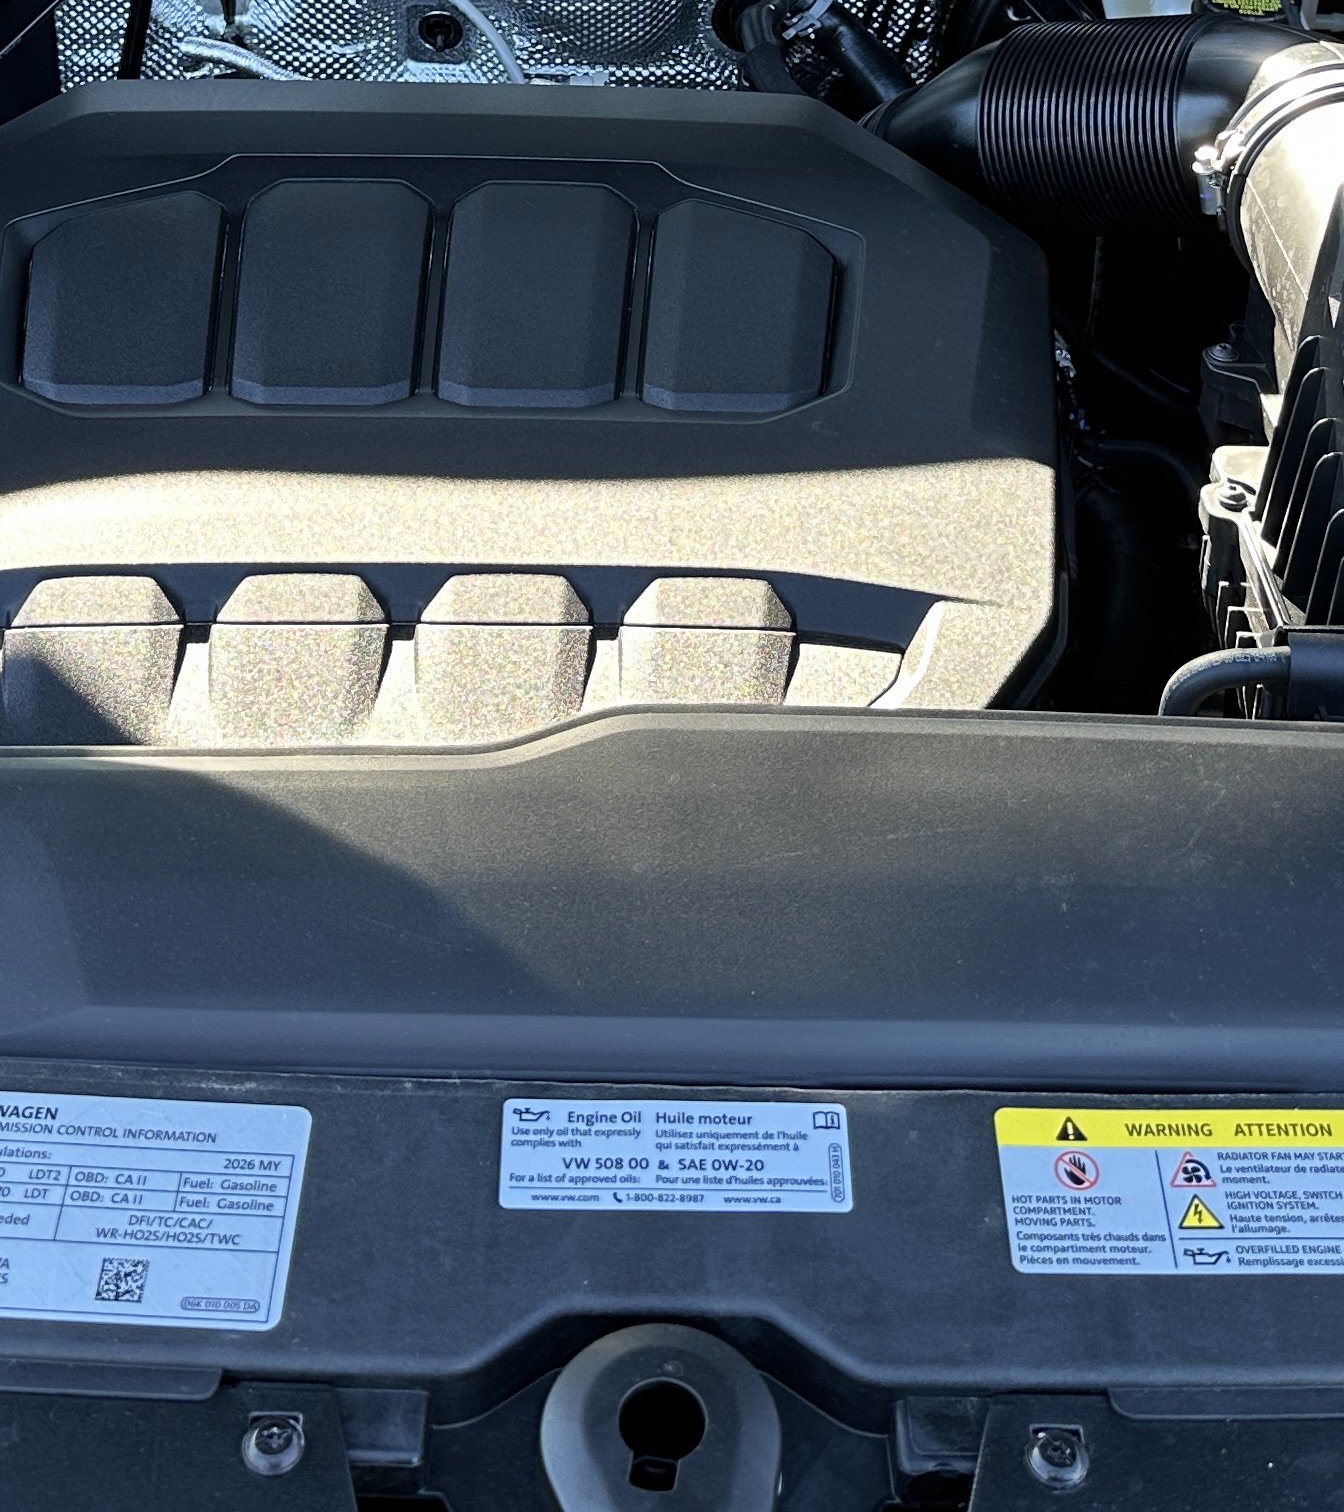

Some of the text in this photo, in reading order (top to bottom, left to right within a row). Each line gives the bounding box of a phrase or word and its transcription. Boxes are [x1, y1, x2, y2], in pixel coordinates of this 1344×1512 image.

[567, 1111, 642, 1126] Engine Oil
[656, 1112, 753, 1125] Huile moteur
[57, 1124, 118, 1139] CONTROL
[123, 1128, 217, 1144] INFORMATION
[512, 1126, 641, 1139] Use only oil that expressly
[656, 1129, 694, 1139] Utilisez
[696, 1130, 759, 1141] uniquement
[762, 1131, 775, 1139] de
[1125, 1123, 1333, 1137] WARNING ATTENTION
[511, 1138, 582, 1148] complies with
[656, 1141, 672, 1151] qui
[675, 1141, 715, 1150] satisfait
[793, 1142, 800, 1151] à
[1217, 1152, 1268, 1161] RADIATOR
[1271, 1152, 1292, 1161] FAN
[1294, 1152, 1315, 1161] MAY
[223, 1158, 282, 1171] 2026 MY
[562, 1157, 765, 1172] VW 508 00 & SAE 0W-20
[1220, 1165, 1232, 1174] Le
[1234, 1165, 1292, 1174] ventilateur
[1294, 1165, 1306, 1174] de
[29, 1168, 61, 1180] LDT2
[74, 1171, 108, 1184] OBD:
[115, 1174, 133, 1186] CA
[509, 1173, 526, 1182] For
[537, 1173, 553, 1182] list
[555, 1173, 566, 1182] of
[568, 1174, 617, 1185] approved
[656, 1175, 679, 1184] Pour
[681, 1176, 700, 1184] une
[702, 1175, 723, 1184] liste
[182, 1177, 278, 1193] Fuel: Gasoline
[1222, 1176, 1270, 1184] moment.
[24, 1187, 51, 1199] LDT
[70, 1190, 104, 1203] OBD:
[111, 1193, 129, 1204] CA
[530, 1192, 704, 1203] www.vw.com 1-800-822-8987
[1225, 1191, 1252, 1200] HIGH
[1254, 1191, 1302, 1201] VOLTAGE,
[1302, 1191, 1342, 1200] SWITCH
[179, 1196, 274, 1212] Fuel: Gasoline
[724, 1195, 782, 1204] www.vw.ca
[1012, 1195, 1122, 1205] HOT PARTS IN MOTOR
[1013, 1206, 1096, 1216] COMPARTMENT.
[1227, 1201, 1320, 1210] IGNITION SYSTEM.
[1015, 1217, 1096, 1227] MOVING PARTS.
[1230, 1214, 1262, 1223] Haute
[1264, 1214, 1307, 1224] tension,
[1016, 1231, 1166, 1242] Composants très chauds dans
[1018, 1243, 1152, 1254] le compartiment moteur.
[1235, 1245, 1300, 1254] OVERFILLED
[1302, 1245, 1341, 1254] ENGINE
[1019, 1255, 1054, 1265] Pièces
[1072, 1257, 1140, 1265] mouvement.
[1238, 1256, 1305, 1268] Remplissage
